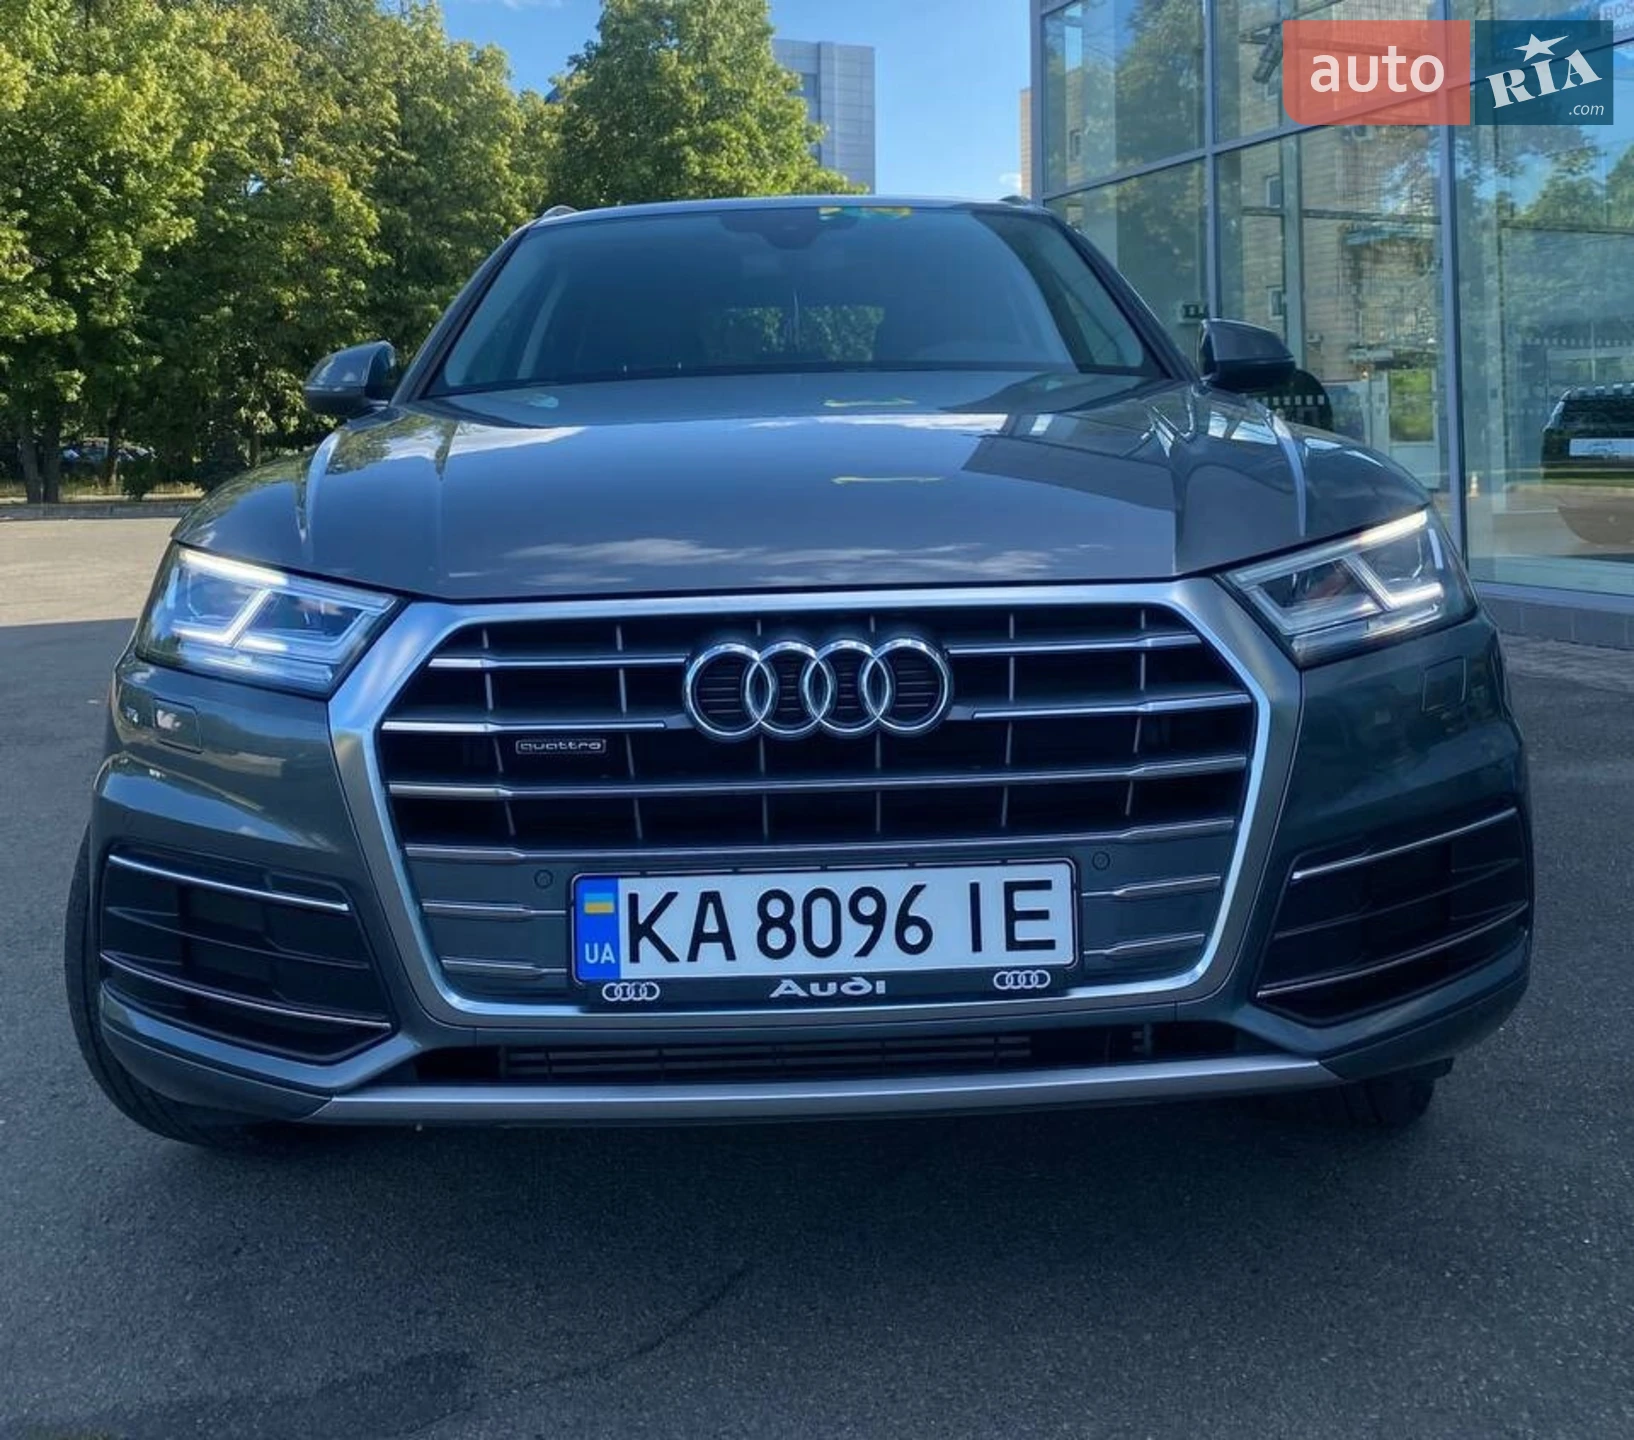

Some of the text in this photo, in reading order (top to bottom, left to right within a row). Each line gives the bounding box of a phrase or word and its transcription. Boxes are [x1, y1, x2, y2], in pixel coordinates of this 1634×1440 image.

[520, 741, 601, 752] quattro
[627, 879, 1056, 963] KA 8096 IE
[584, 942, 616, 964] UA
